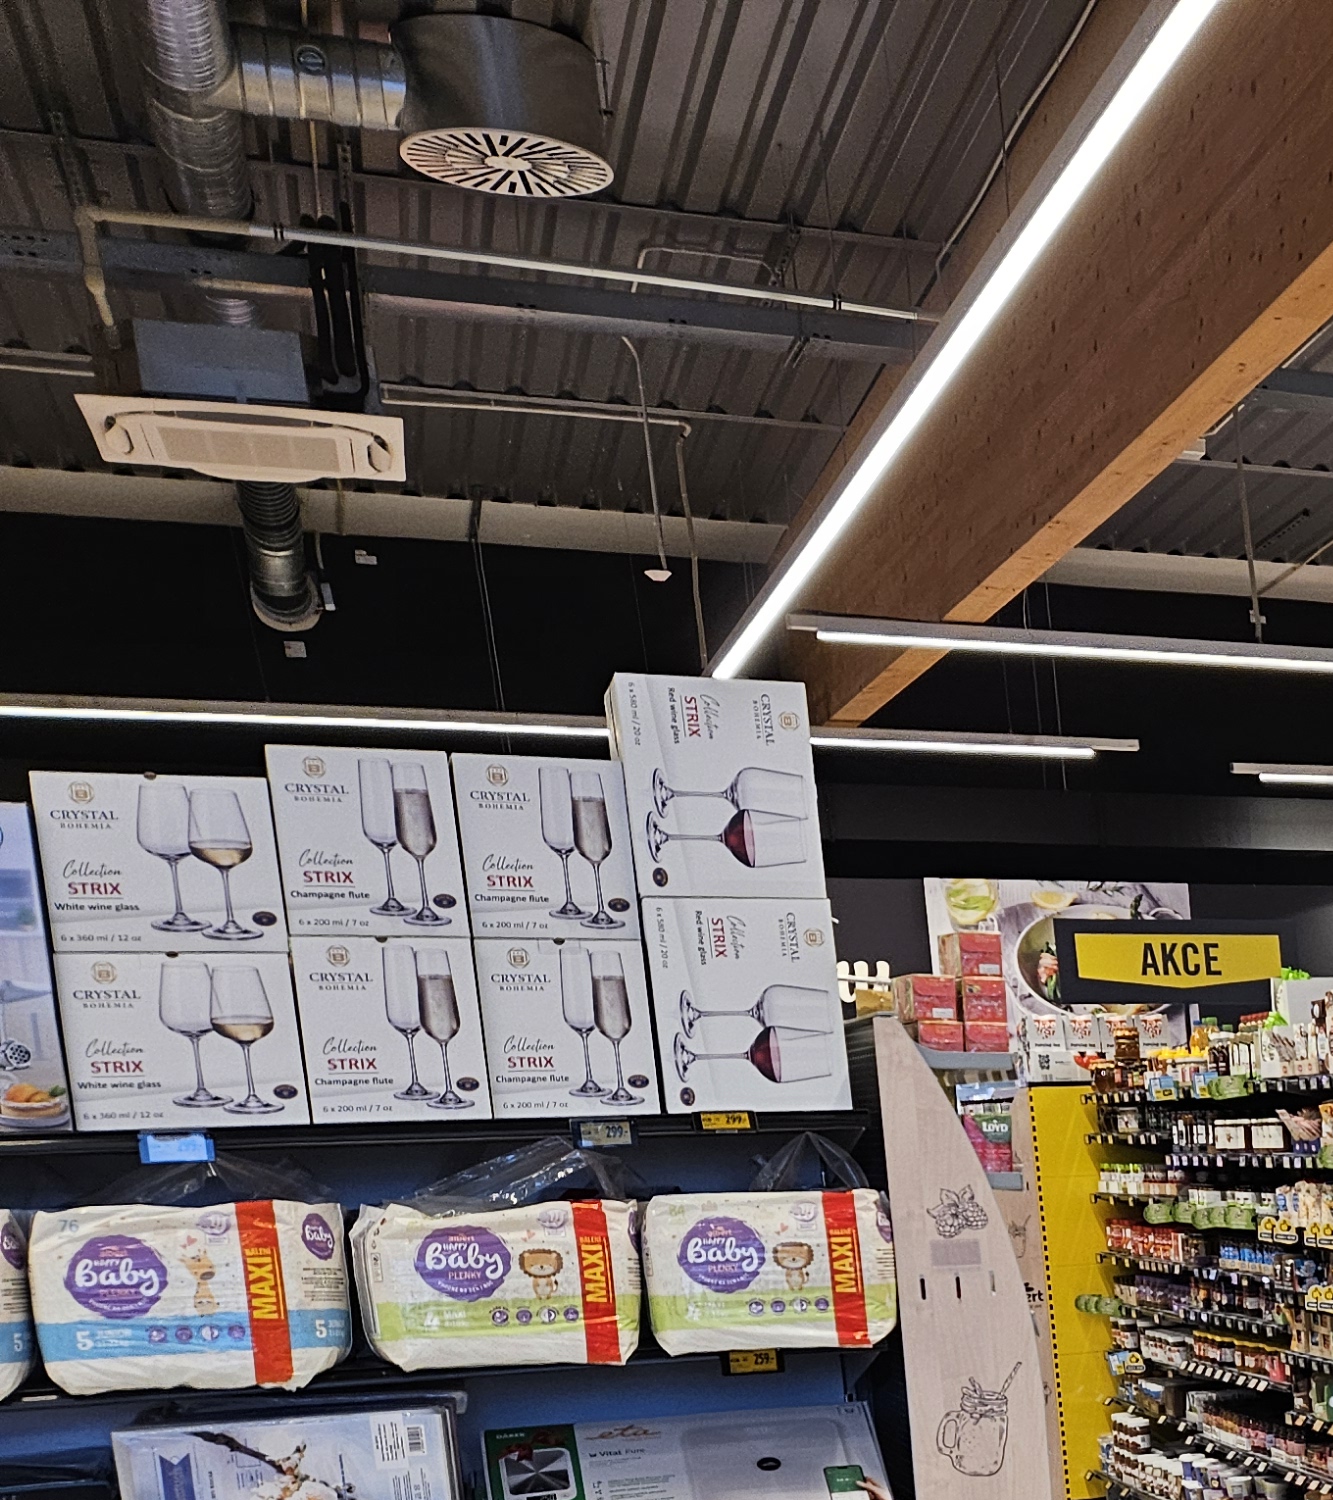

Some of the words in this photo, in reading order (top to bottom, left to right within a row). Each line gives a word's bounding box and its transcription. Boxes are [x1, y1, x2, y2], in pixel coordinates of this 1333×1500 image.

[684, 695, 702, 738] STRIX
[761, 693, 775, 746] CRYSTAL
[284, 783, 349, 795] CRYSTAL
[470, 790, 531, 803] CRYSTAL
[50, 809, 119, 821] CRYSTAL
[303, 871, 355, 884] STRIX
[486, 875, 535, 888] STRIX
[68, 882, 122, 895] STRIX
[290, 890, 346, 900] Champagne
[348, 890, 370, 899] flute
[474, 893, 527, 904] Champagne
[54, 902, 86, 911] White
[87, 903, 113, 911] wine
[115, 903, 140, 912] glass
[711, 917, 728, 958] STRIX
[786, 912, 800, 963] CRYSTAL
[1141, 942, 1222, 976] AKCE
[309, 972, 373, 983] CRYSTAL
[490, 973, 551, 983] CRYSTAL
[327, 1058, 378, 1070] STRIX
[507, 1056, 555, 1068] STRIX
[425, 1242, 504, 1280] Baby
[687, 1237, 758, 1272] Baby
[74, 1258, 160, 1296] Baby
[581, 1243, 608, 1303] MAXI
[248, 1253, 279, 1320] MAXI
